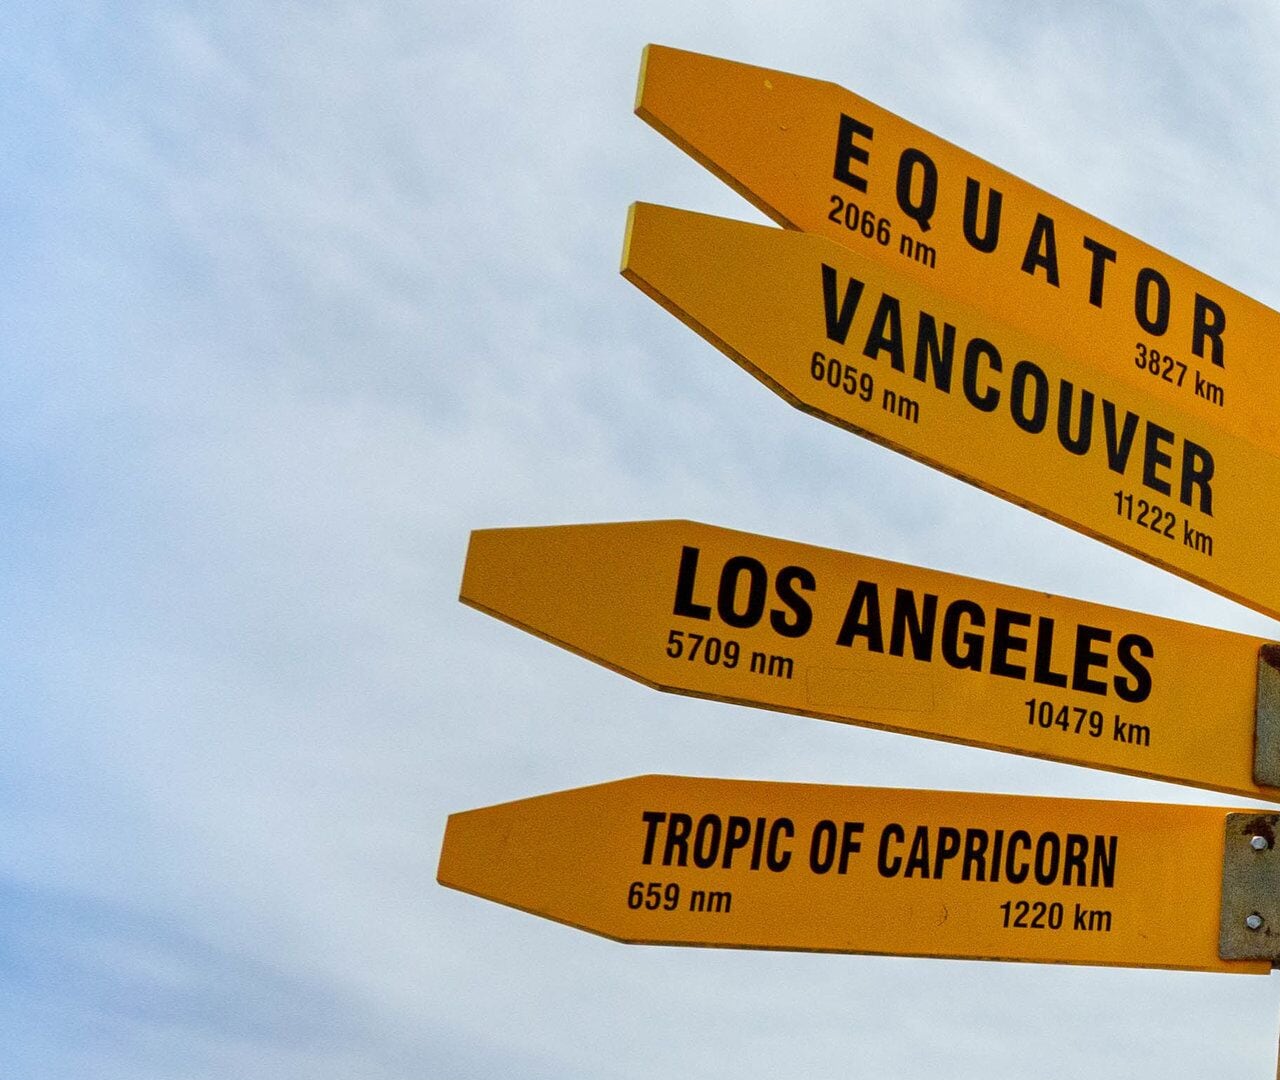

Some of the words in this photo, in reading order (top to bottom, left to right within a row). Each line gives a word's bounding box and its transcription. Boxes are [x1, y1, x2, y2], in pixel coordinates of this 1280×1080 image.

[828, 194, 892, 248] 2066
[899, 233, 937, 269] nm
[833, 113, 1227, 371] EQUATOR
[810, 351, 874, 403] 6059
[881, 388, 920, 424] nm
[820, 263, 1216, 518] VANCOUVER
[1134, 343, 1188, 387] 3827
[1194, 371, 1225, 407] km
[1113, 489, 1177, 541] 11222
[1182, 518, 1214, 557] km
[666, 629, 741, 669] 5709
[749, 650, 795, 680] nm
[672, 545, 817, 640] LOS
[835, 580, 1155, 704] ANGELES
[1024, 697, 1105, 739] 10479
[1112, 714, 1152, 748] km
[641, 810, 795, 873] TROPIC
[808, 819, 865, 875] OF
[876, 822, 1119, 889] CAPRICORN
[627, 881, 681, 911] 659
[688, 889, 733, 915] nm
[998, 899, 1065, 930] 1220
[1072, 902, 1113, 932] km
